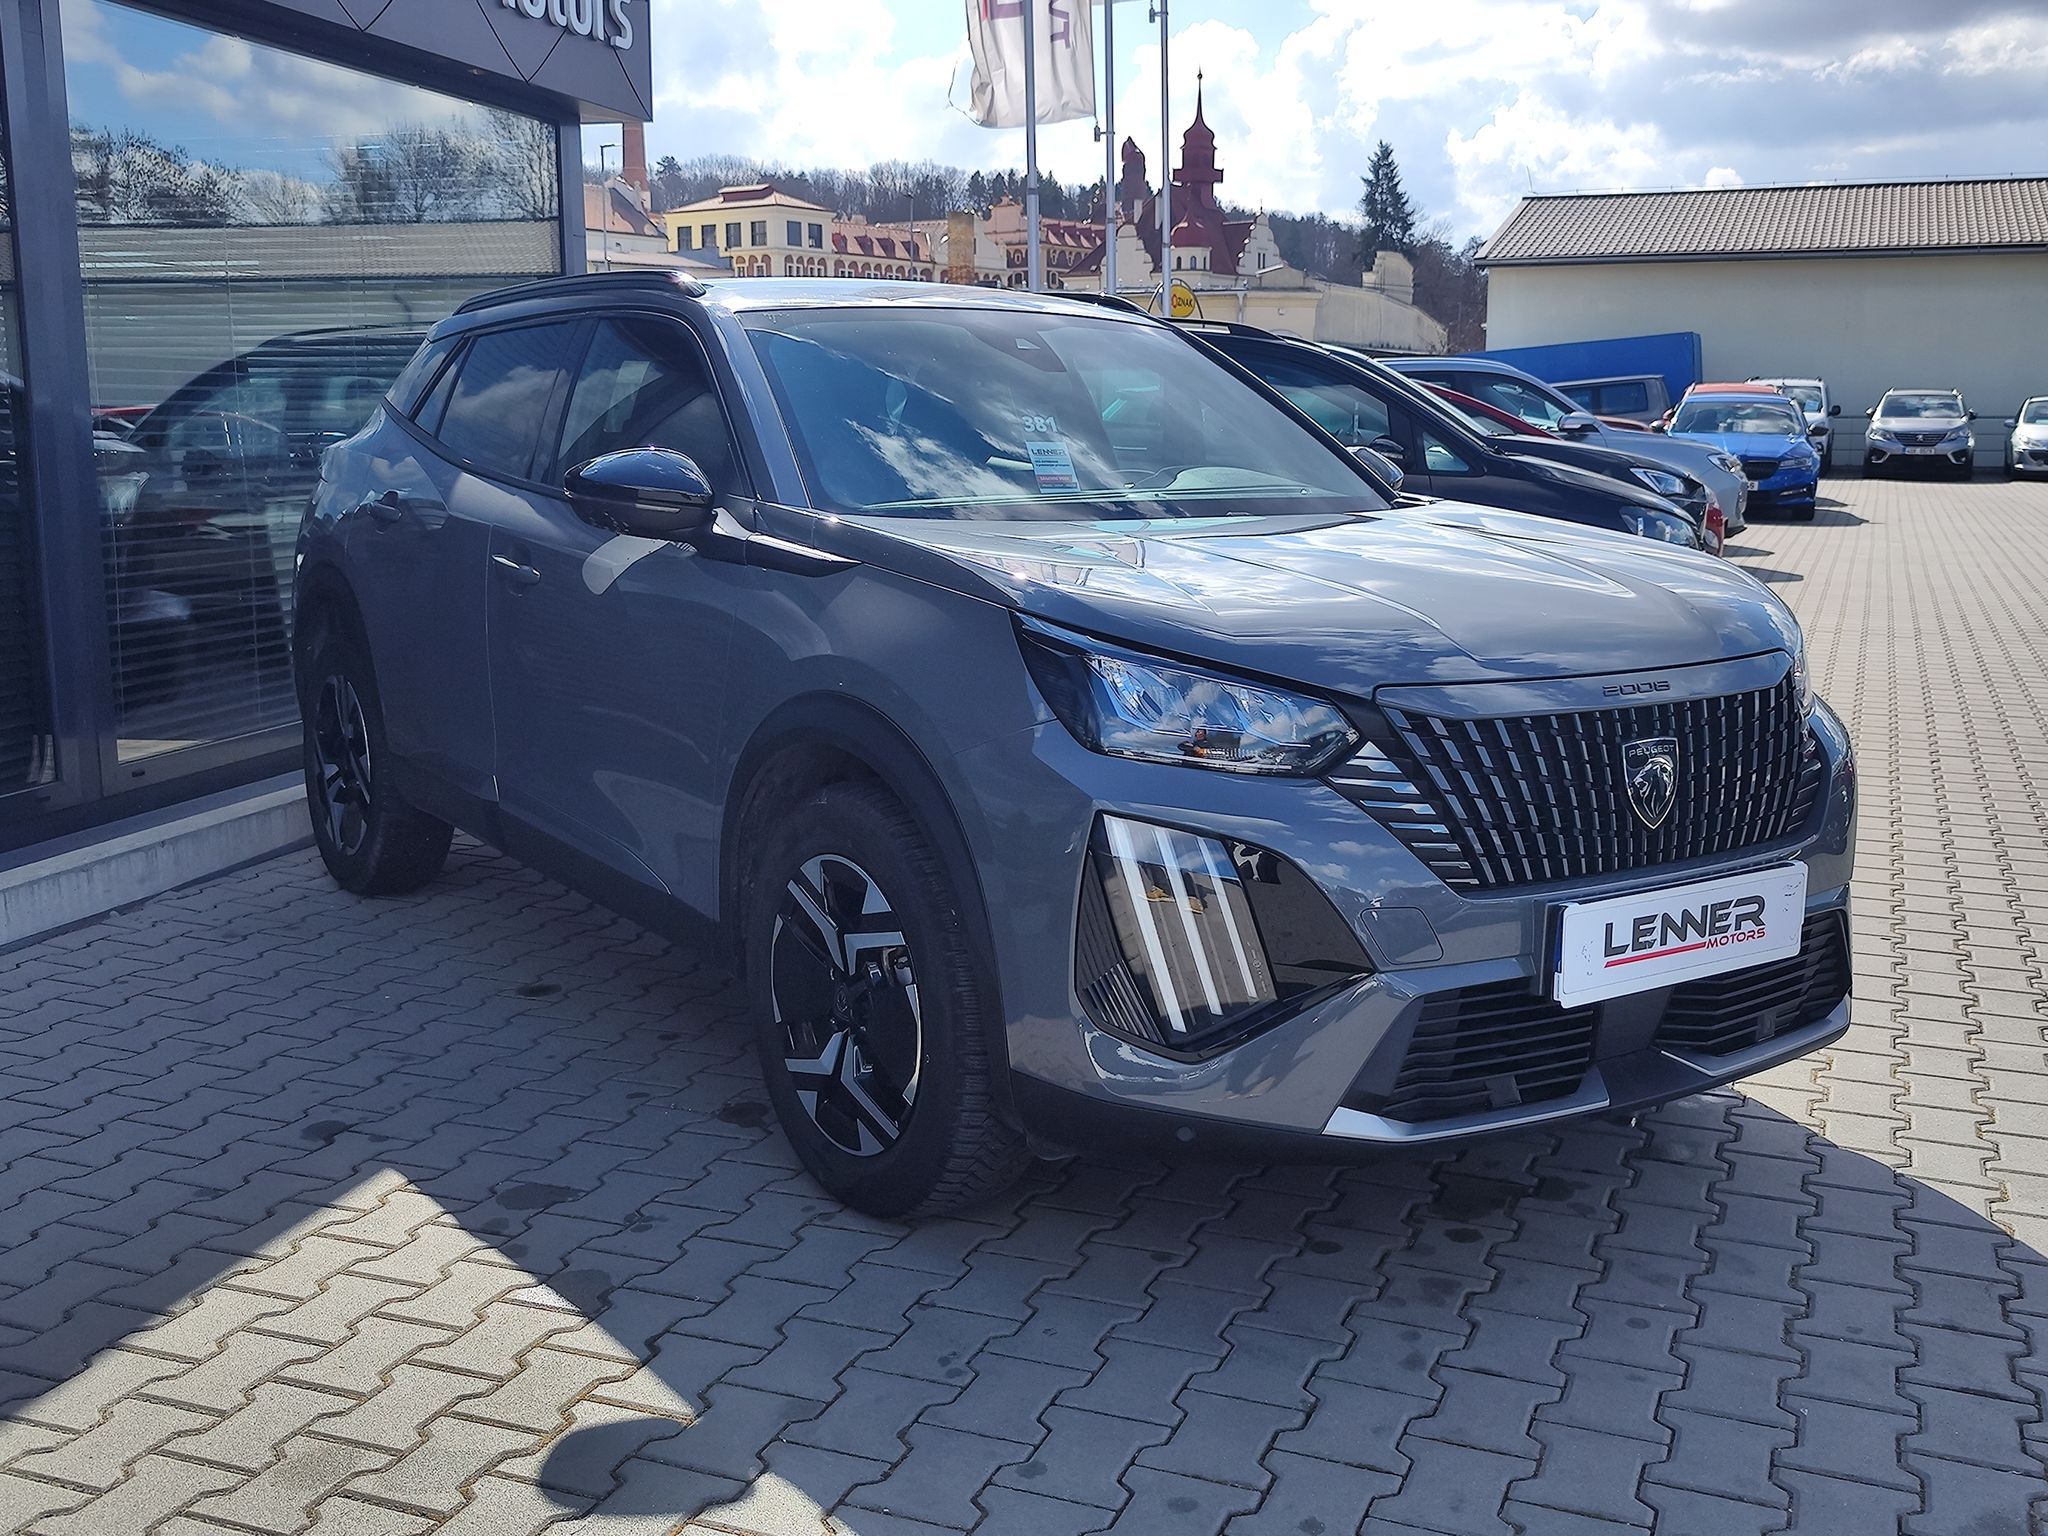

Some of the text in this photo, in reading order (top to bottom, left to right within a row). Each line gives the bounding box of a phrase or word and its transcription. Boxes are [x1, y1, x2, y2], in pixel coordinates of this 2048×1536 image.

[1022, 415, 1058, 432] 381
[1602, 680, 1671, 697] 2008
[1629, 744, 1675, 757] PEUGEOT
[1603, 895, 1766, 958] LENNER
[1705, 927, 1766, 950] MOTORS
